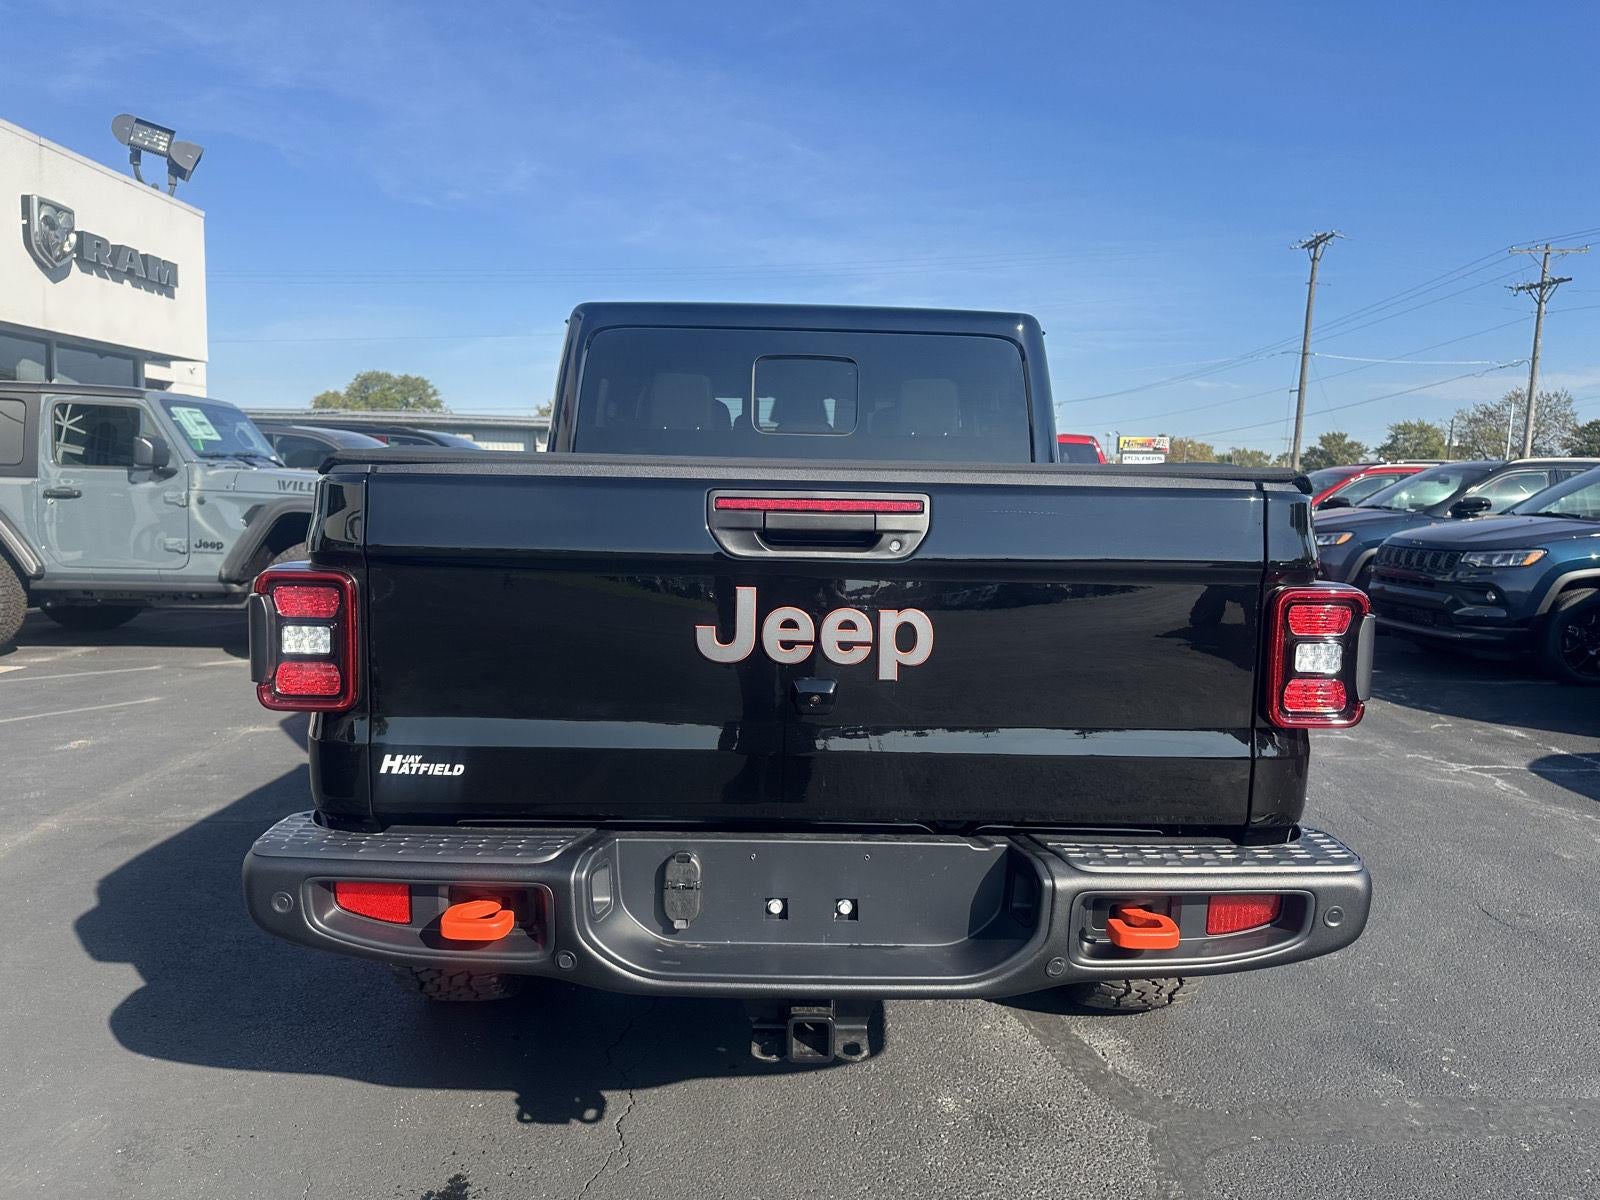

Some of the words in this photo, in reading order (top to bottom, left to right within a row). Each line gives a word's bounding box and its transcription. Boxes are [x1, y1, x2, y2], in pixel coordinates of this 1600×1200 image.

[77, 231, 178, 288] RAM
[194, 539, 225, 550] Jeep
[695, 586, 934, 681] Jeep
[379, 754, 465, 776] HATFIELD
[402, 754, 423, 764] JAY
